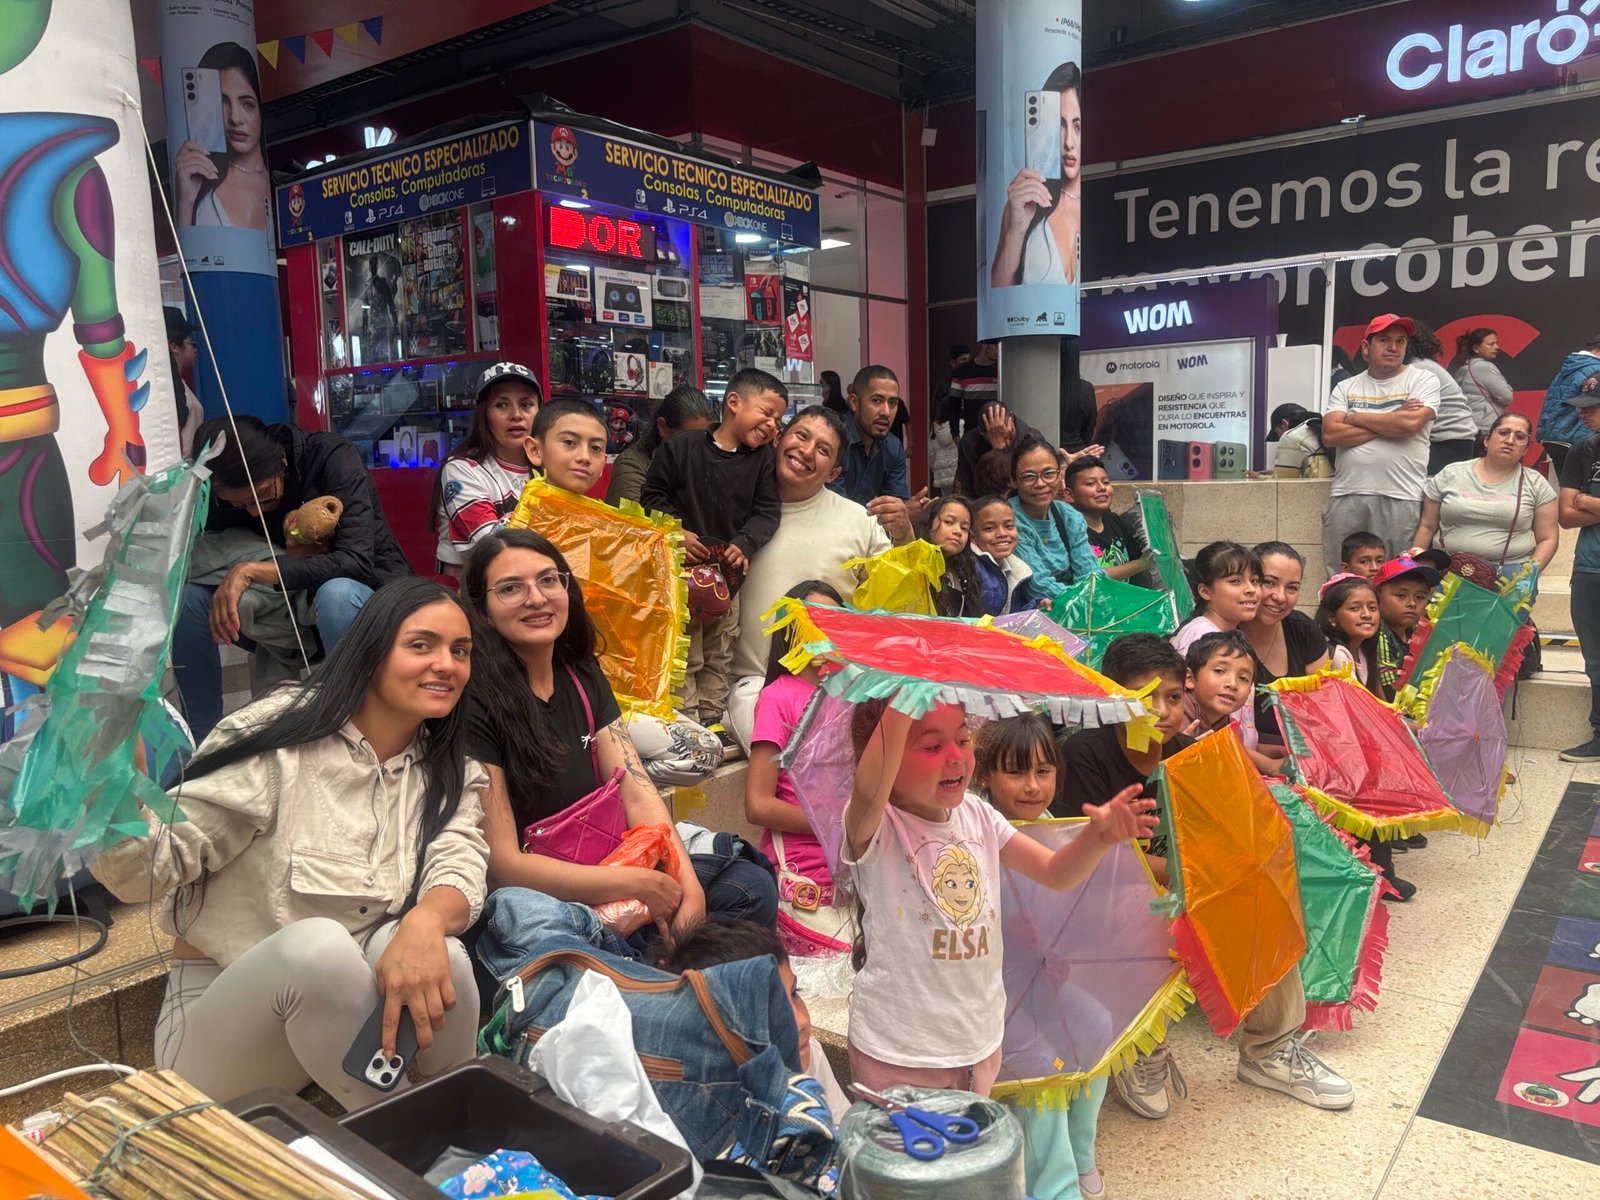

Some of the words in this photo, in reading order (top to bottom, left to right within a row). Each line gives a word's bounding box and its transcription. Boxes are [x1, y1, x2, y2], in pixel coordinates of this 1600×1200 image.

[1386, 14, 1590, 90] Claro
[321, 167, 370, 199] SERVICIO
[371, 153, 421, 182] TECNICO
[424, 125, 519, 170] ESPECIALIZADO
[350, 185, 399, 208] Consolas,
[401, 161, 486, 195] Computadoras
[605, 141, 669, 176] SERVICIO
[672, 159, 727, 191] TECNICO
[731, 175, 812, 212] ESPECIALIZADO
[643, 174, 702, 205] Consolas,
[706, 188, 786, 221] Computadoras
[1114, 161, 1424, 244] Tenemos
[1444, 138, 1511, 200] la
[378, 204, 404, 219] PS4
[679, 203, 708, 220] PS4
[349, 238, 372, 257] CALL
[373, 232, 395, 252] DUTY
[422, 226, 447, 247] grand
[428, 242, 453, 258] theft
[1123, 299, 1194, 335] WOM
[483, 361, 529, 382] NYC
[1119, 359, 1160, 371] motorola
[1176, 354, 1209, 371] WOM
[1158, 391, 1188, 402] DISEÑO
[1188, 392, 1206, 401] QUE
[1206, 391, 1238, 400] INSPIRA
[1239, 390, 1246, 399] Y
[1158, 402, 1208, 412] RESISTENCIA
[1209, 401, 1226, 410] QUE
[1158, 412, 1181, 422] DURA
[1181, 412, 1193, 421] LO
[1193, 410, 1247, 420] ENCUENTRAS
[1158, 422, 1169, 431] EN
[1170, 421, 1217, 431] MOTOROLA.
[932, 925, 989, 960] ELSA
